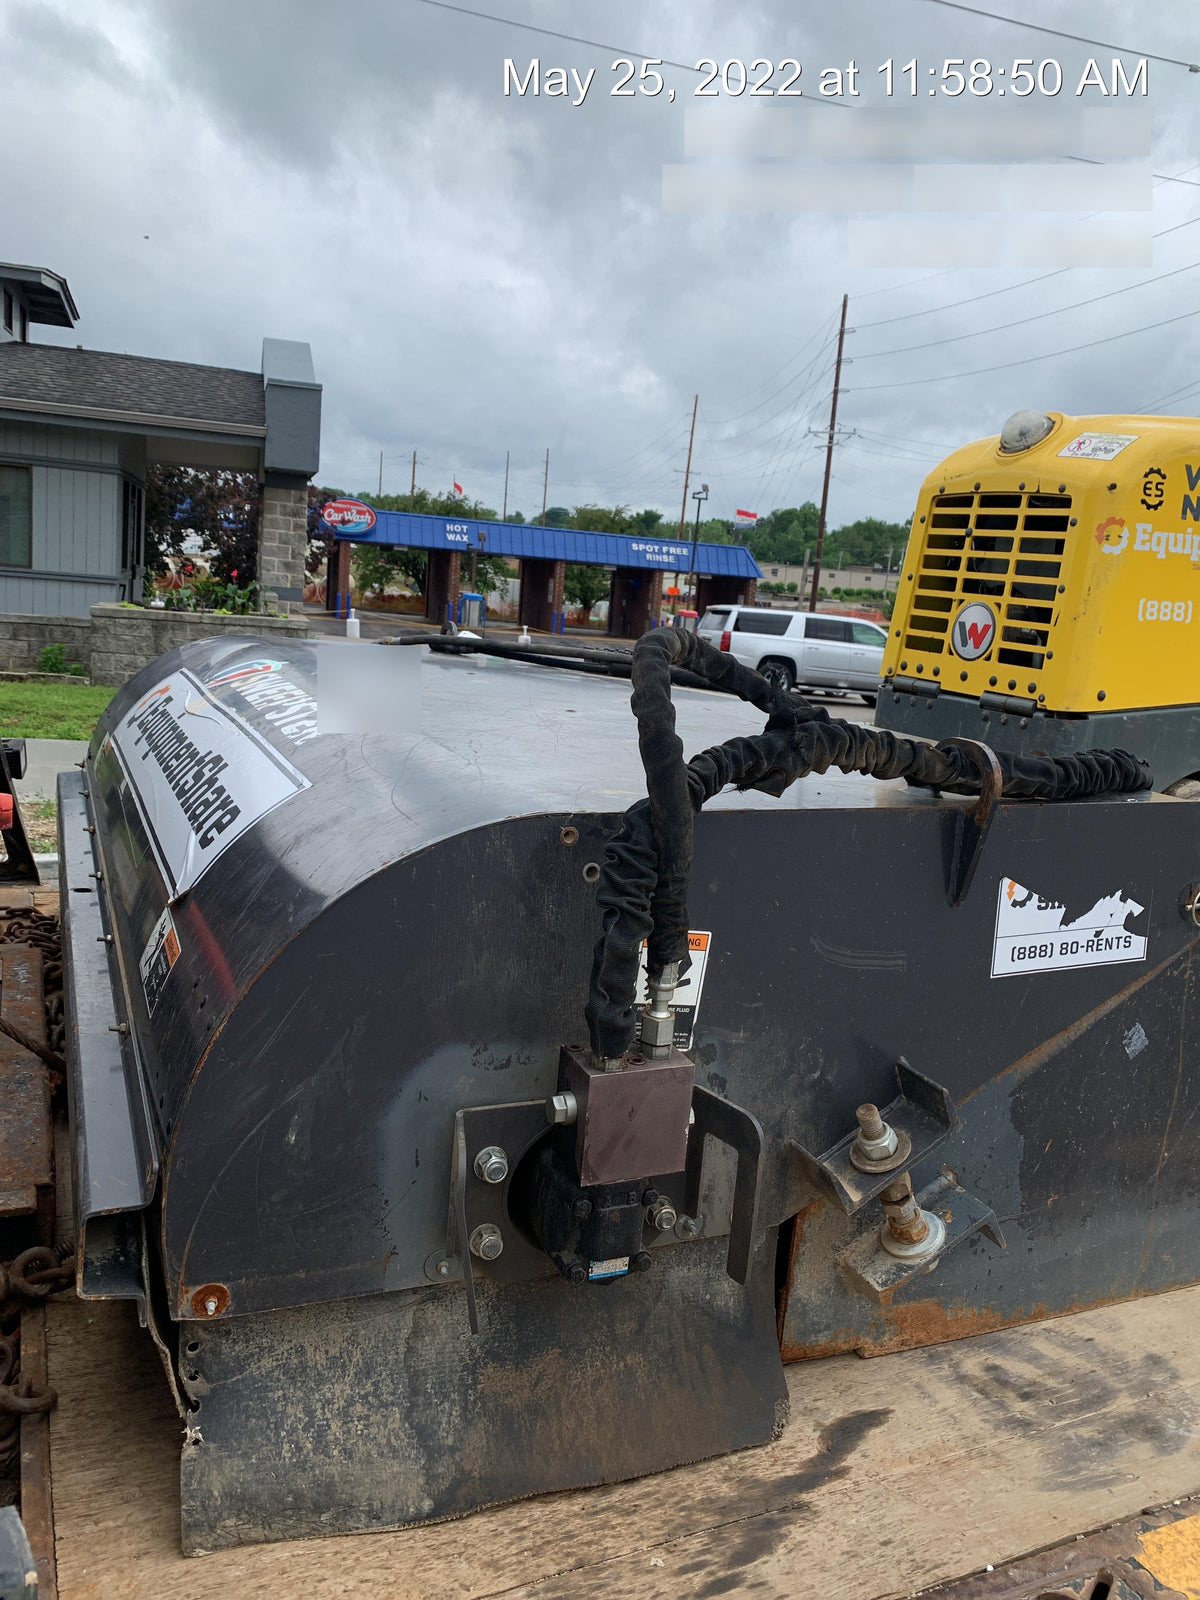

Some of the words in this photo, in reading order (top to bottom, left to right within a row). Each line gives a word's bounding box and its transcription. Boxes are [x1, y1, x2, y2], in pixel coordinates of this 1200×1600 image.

[1143, 481, 1165, 498] ES
[446, 523, 468, 533] HOT
[446, 532, 469, 542] WAX
[631, 542, 660, 553] SPOT
[661, 546, 689, 556] FREE
[645, 553, 676, 563] RINSE
[1138, 598, 1193, 624] (888)
[1010, 942, 1054, 962] (888)
[1059, 935, 1133, 956] 80-RENTS
